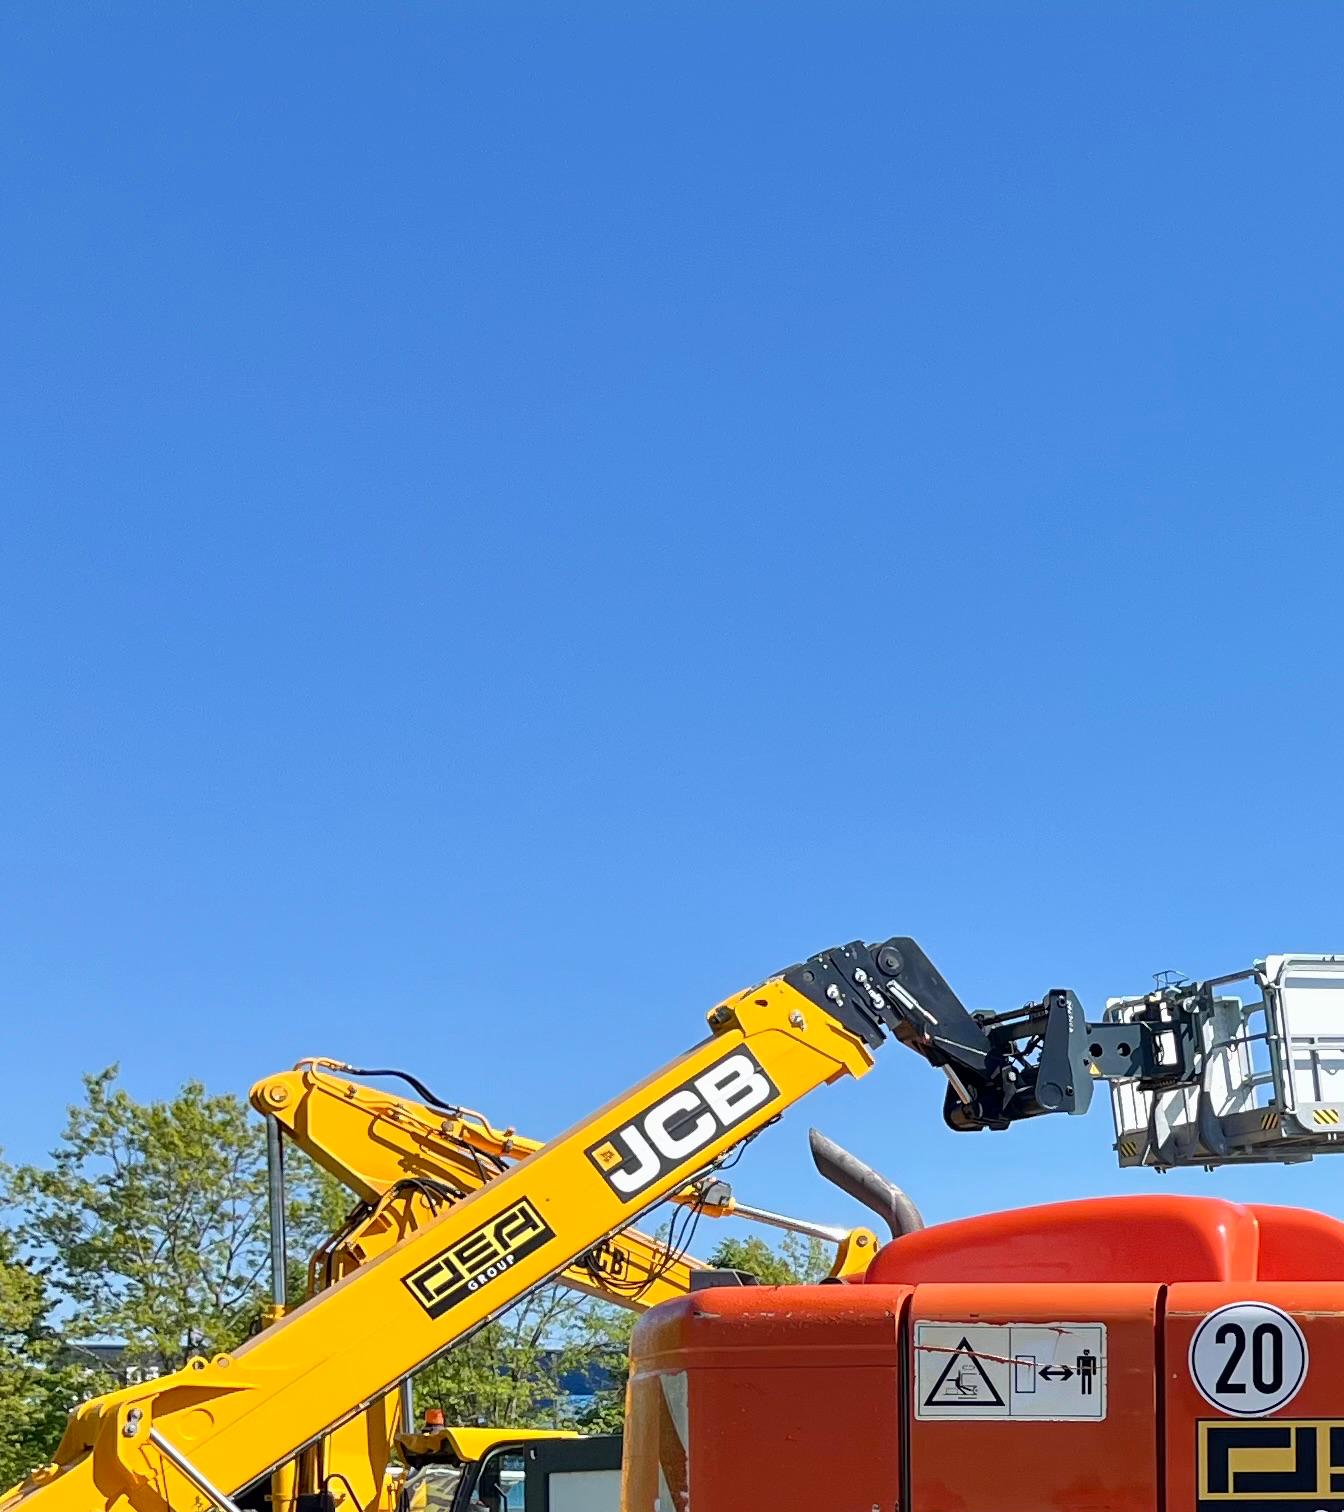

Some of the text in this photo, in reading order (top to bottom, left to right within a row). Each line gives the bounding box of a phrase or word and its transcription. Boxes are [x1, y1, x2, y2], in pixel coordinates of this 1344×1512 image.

[609, 1054, 770, 1193] JCB
[466, 1254, 516, 1291] GROUP
[1215, 1323, 1283, 1394] 20
